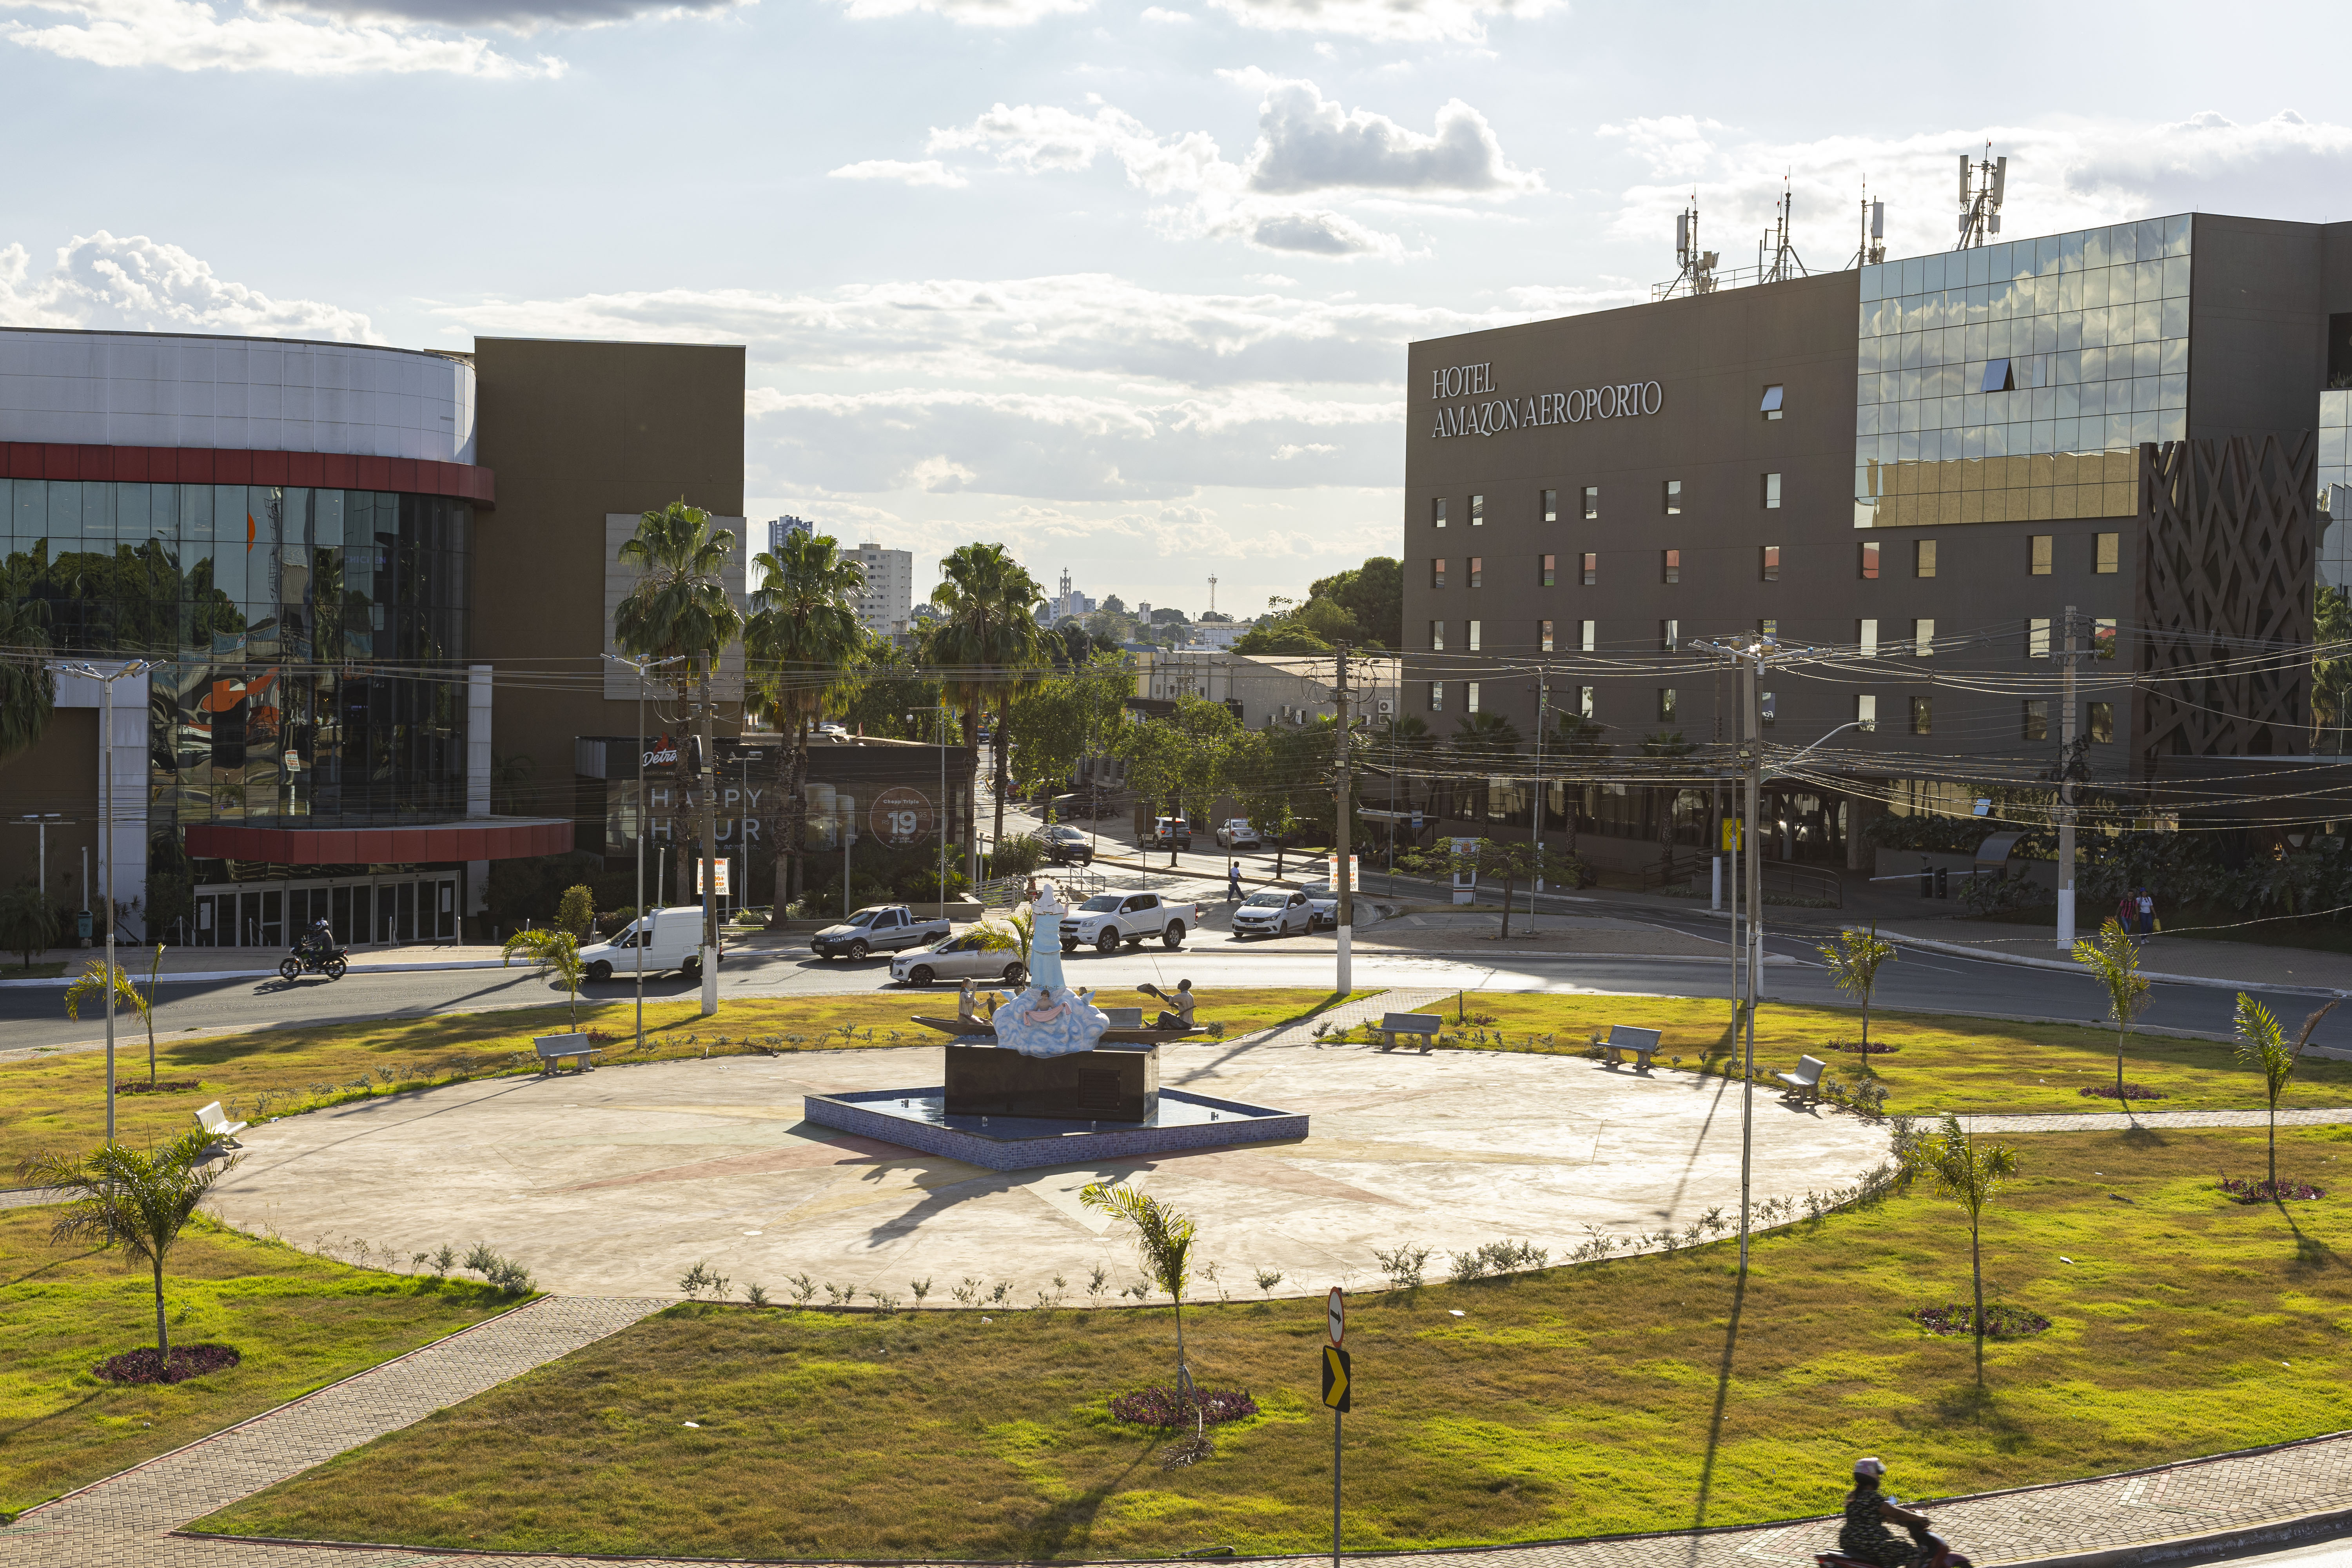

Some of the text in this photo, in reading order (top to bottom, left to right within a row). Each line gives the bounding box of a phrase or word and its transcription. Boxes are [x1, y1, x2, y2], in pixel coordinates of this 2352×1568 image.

[1432, 363, 1495, 399] HOTEL
[1432, 381, 1662, 438] AMAZON AEROPORTO
[651, 788, 763, 808] HAPY
[651, 818, 760, 841] HUR
